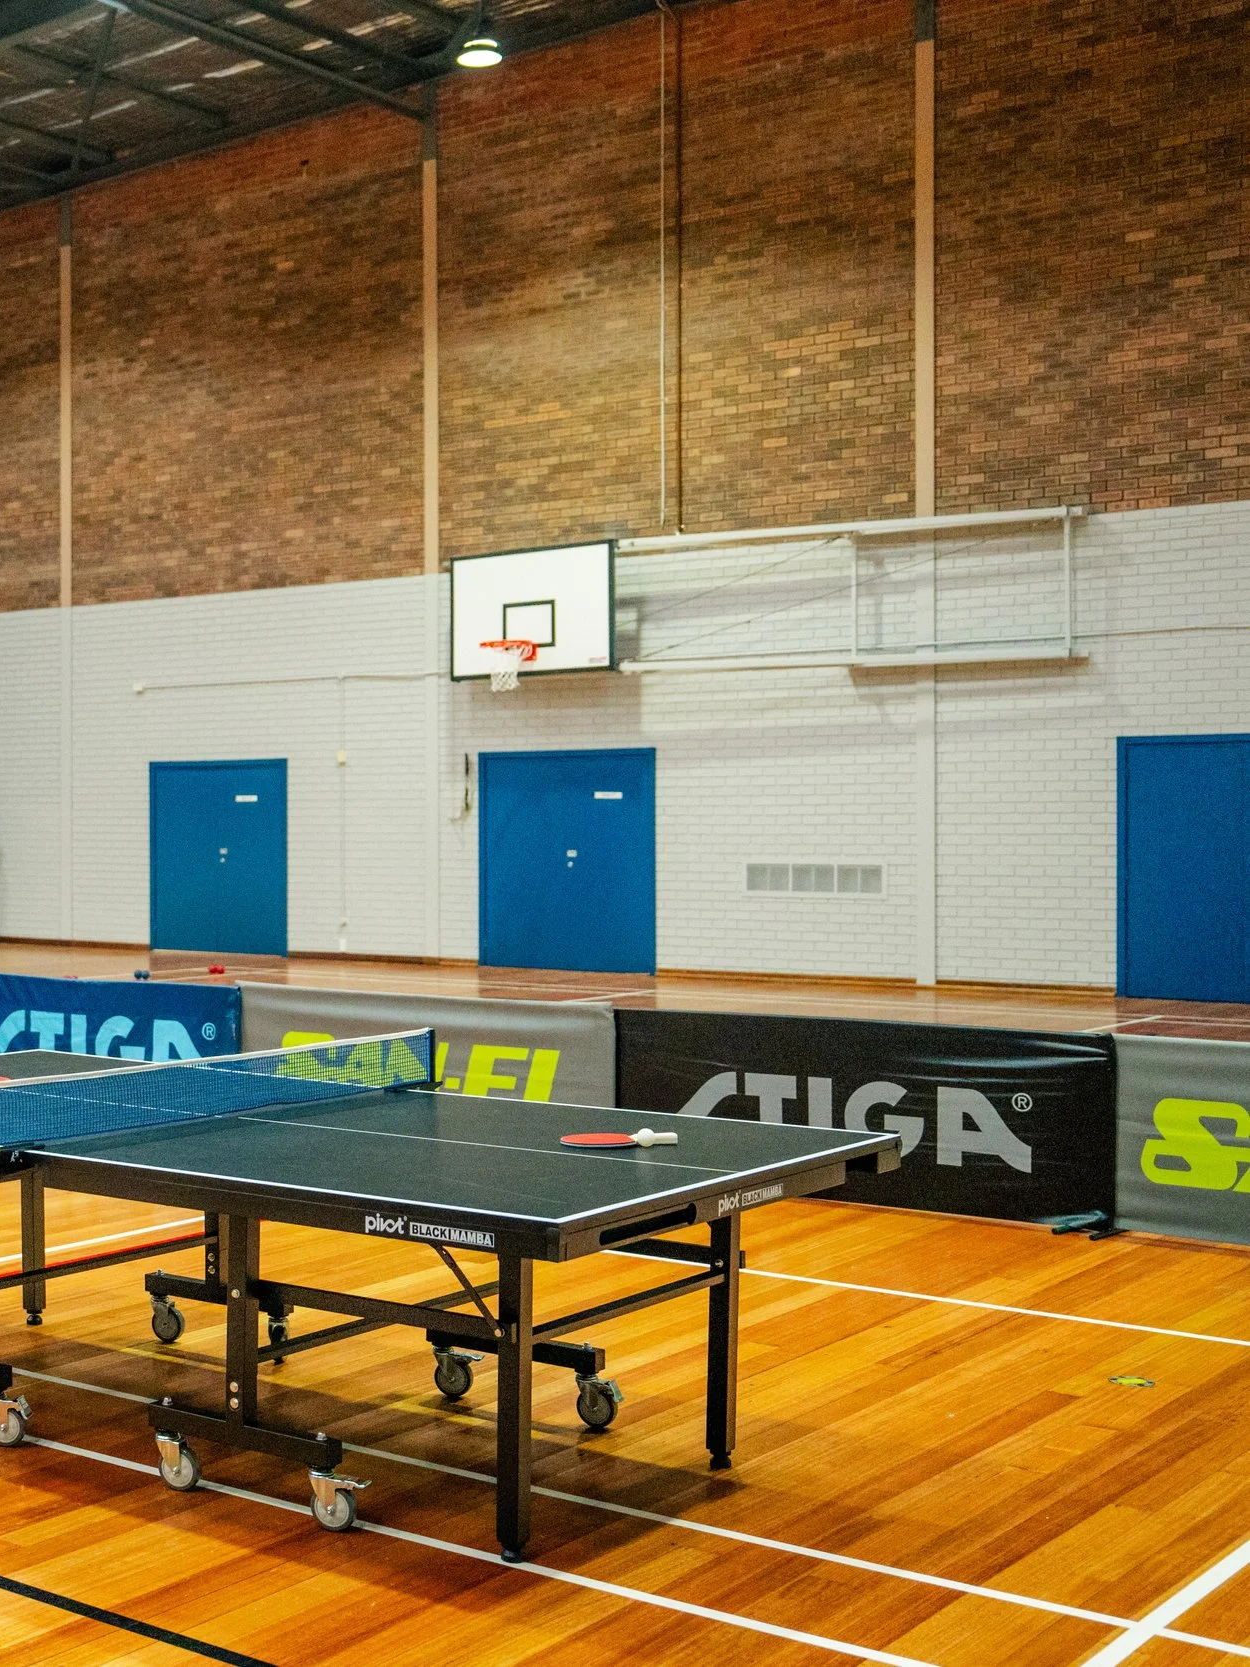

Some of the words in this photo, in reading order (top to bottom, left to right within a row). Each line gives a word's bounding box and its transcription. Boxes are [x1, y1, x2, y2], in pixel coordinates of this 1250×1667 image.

[364, 1213, 406, 1234] pivot
[411, 1224, 448, 1239] BLACK
[449, 1228, 493, 1246] MAMBA
